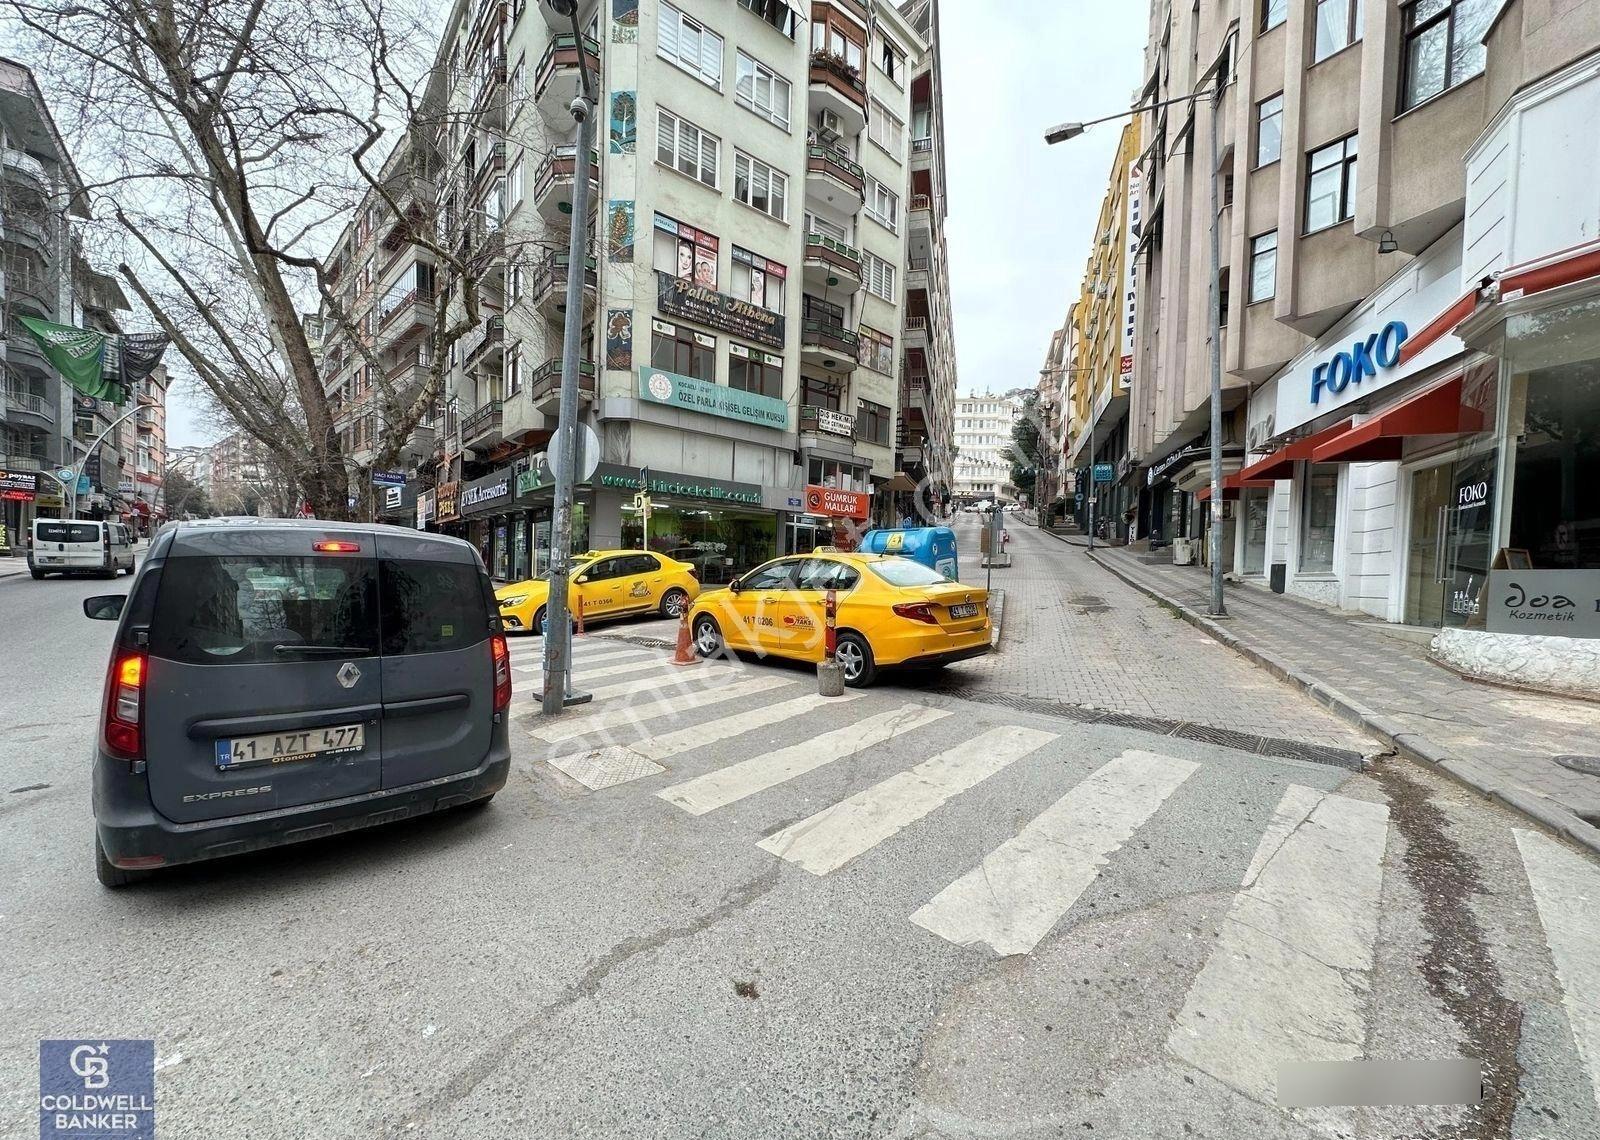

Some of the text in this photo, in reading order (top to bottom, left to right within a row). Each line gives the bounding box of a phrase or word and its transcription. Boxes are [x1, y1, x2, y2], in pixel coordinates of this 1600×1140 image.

[675, 279, 777, 326] Pallas Athena
[1310, 320, 1409, 405] FOKO
[678, 391, 696, 405] ÖZEL
[766, 412, 786, 424] KURSU
[1459, 481, 1488, 504] FOKO
[824, 502, 857, 513] MALLARI
[1508, 609, 1576, 622] Kozmetik
[233, 740, 258, 762] 41
[272, 732, 311, 755] AZT
[322, 727, 359, 747] 477
[271, 752, 317, 763] Otonova
[183, 785, 272, 803] EXPRESS
